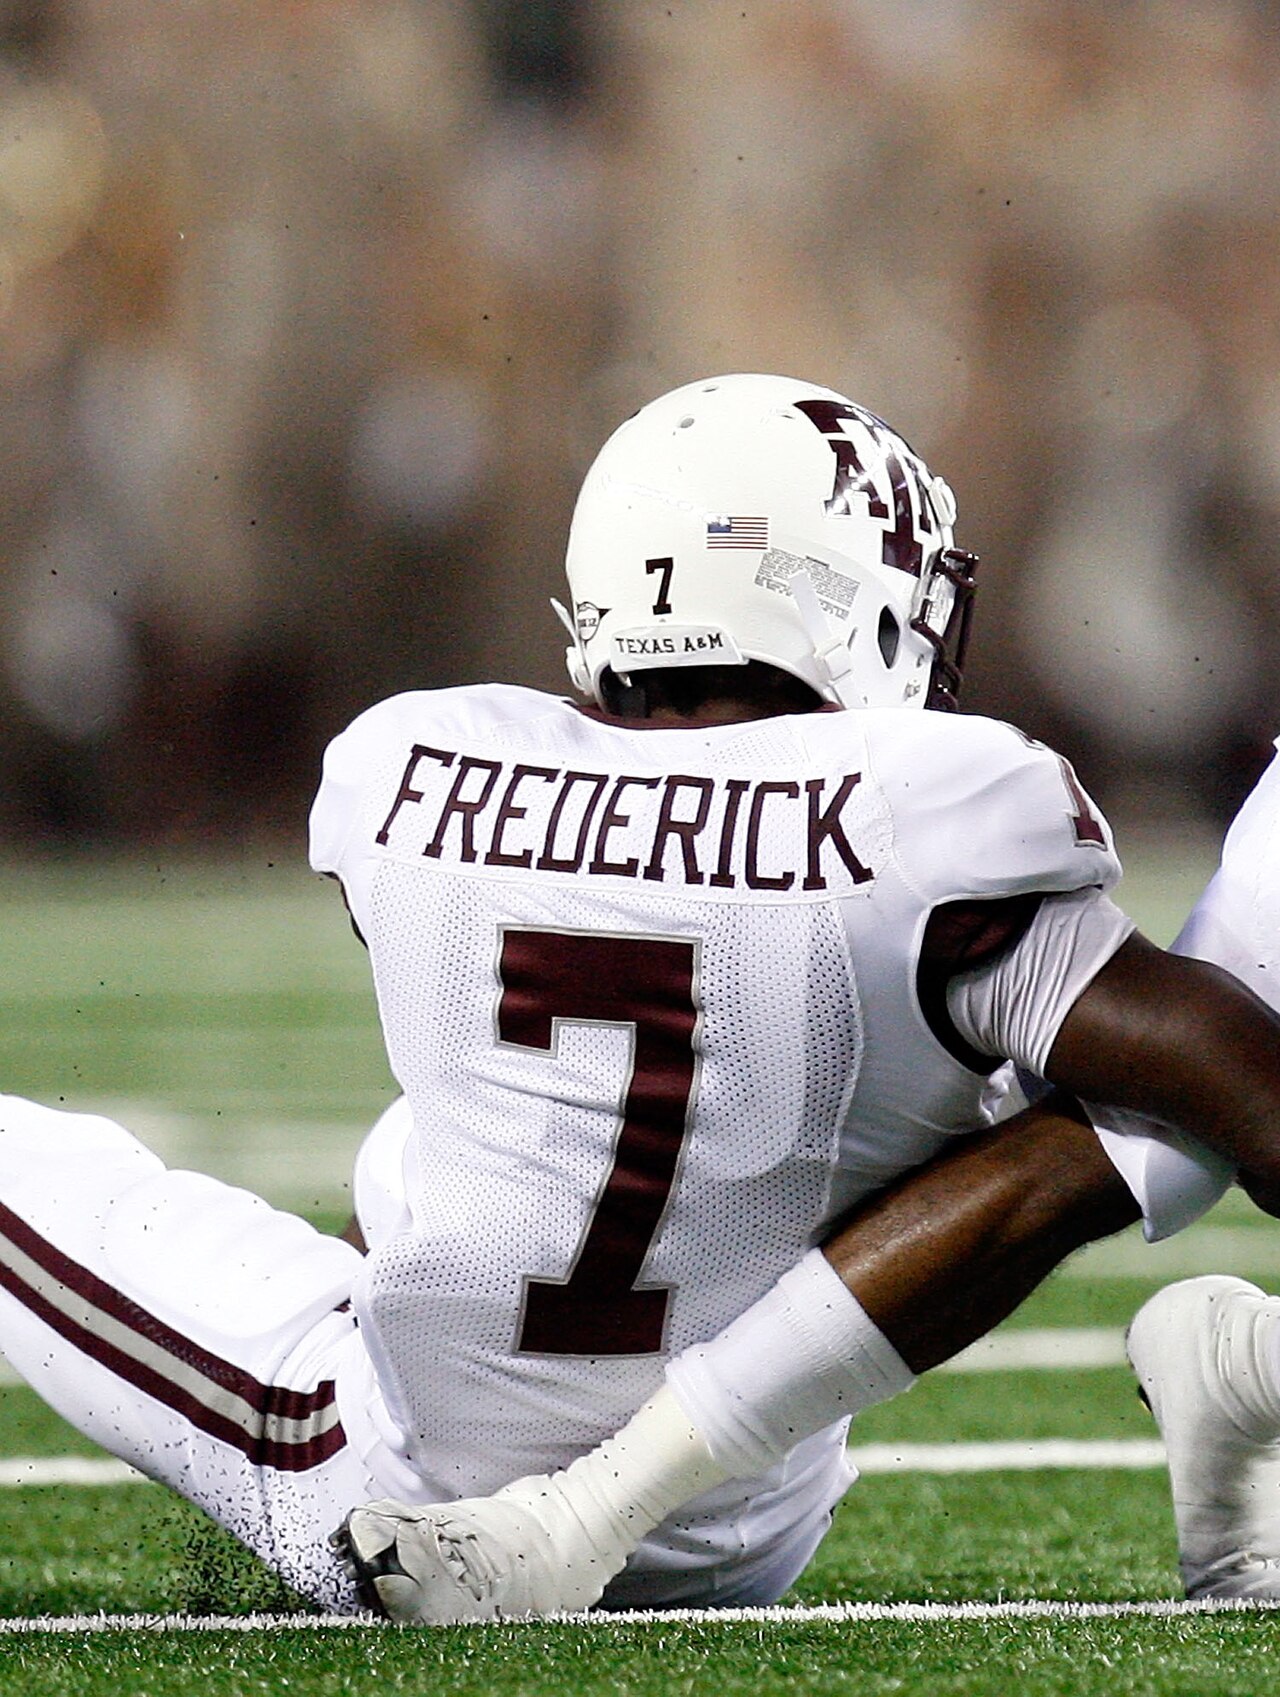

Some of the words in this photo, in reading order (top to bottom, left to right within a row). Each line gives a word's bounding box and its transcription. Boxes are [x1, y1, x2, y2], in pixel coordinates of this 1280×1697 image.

[645, 557, 674, 615] 7
[615, 637, 674, 654] TEXAS
[684, 632, 723, 652] A&M
[376, 744, 874, 891] FREDERICK
[496, 922, 703, 1357] 7
